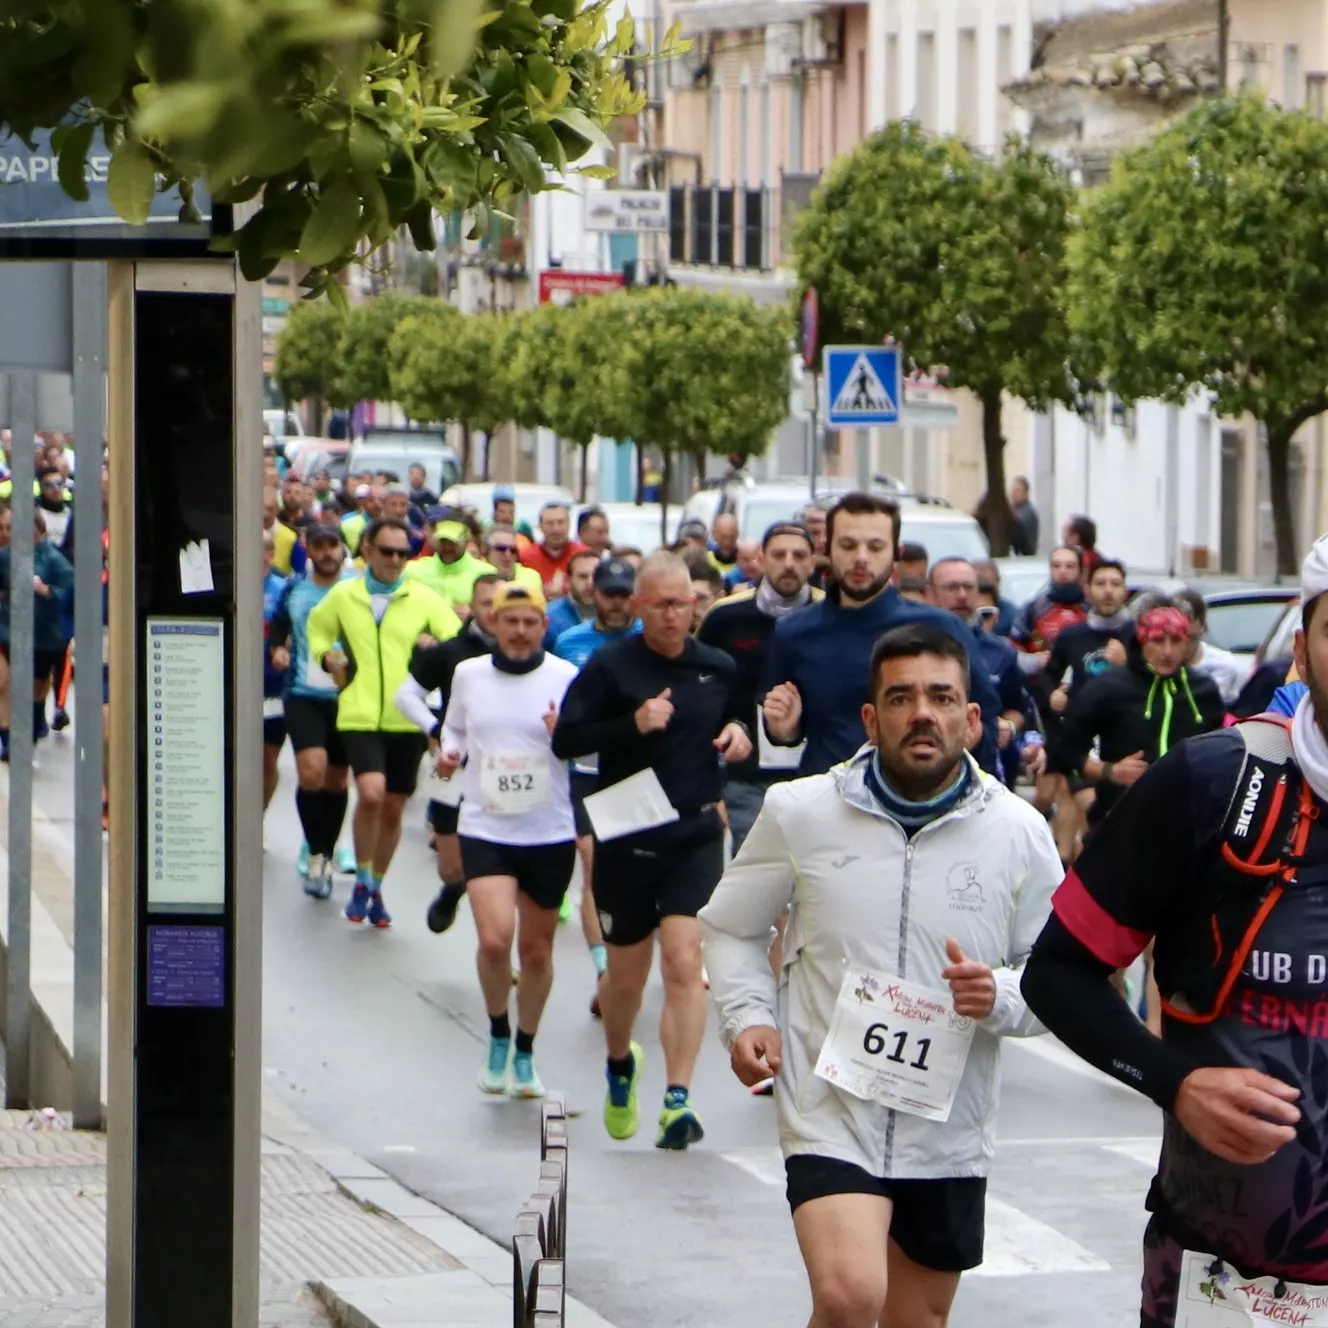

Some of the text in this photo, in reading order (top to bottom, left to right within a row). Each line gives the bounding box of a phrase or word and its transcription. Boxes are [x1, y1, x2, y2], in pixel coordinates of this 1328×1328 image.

[498, 774, 534, 792] 852
[863, 1022, 932, 1071] 611
[1252, 1298, 1314, 1327] LUCENA
